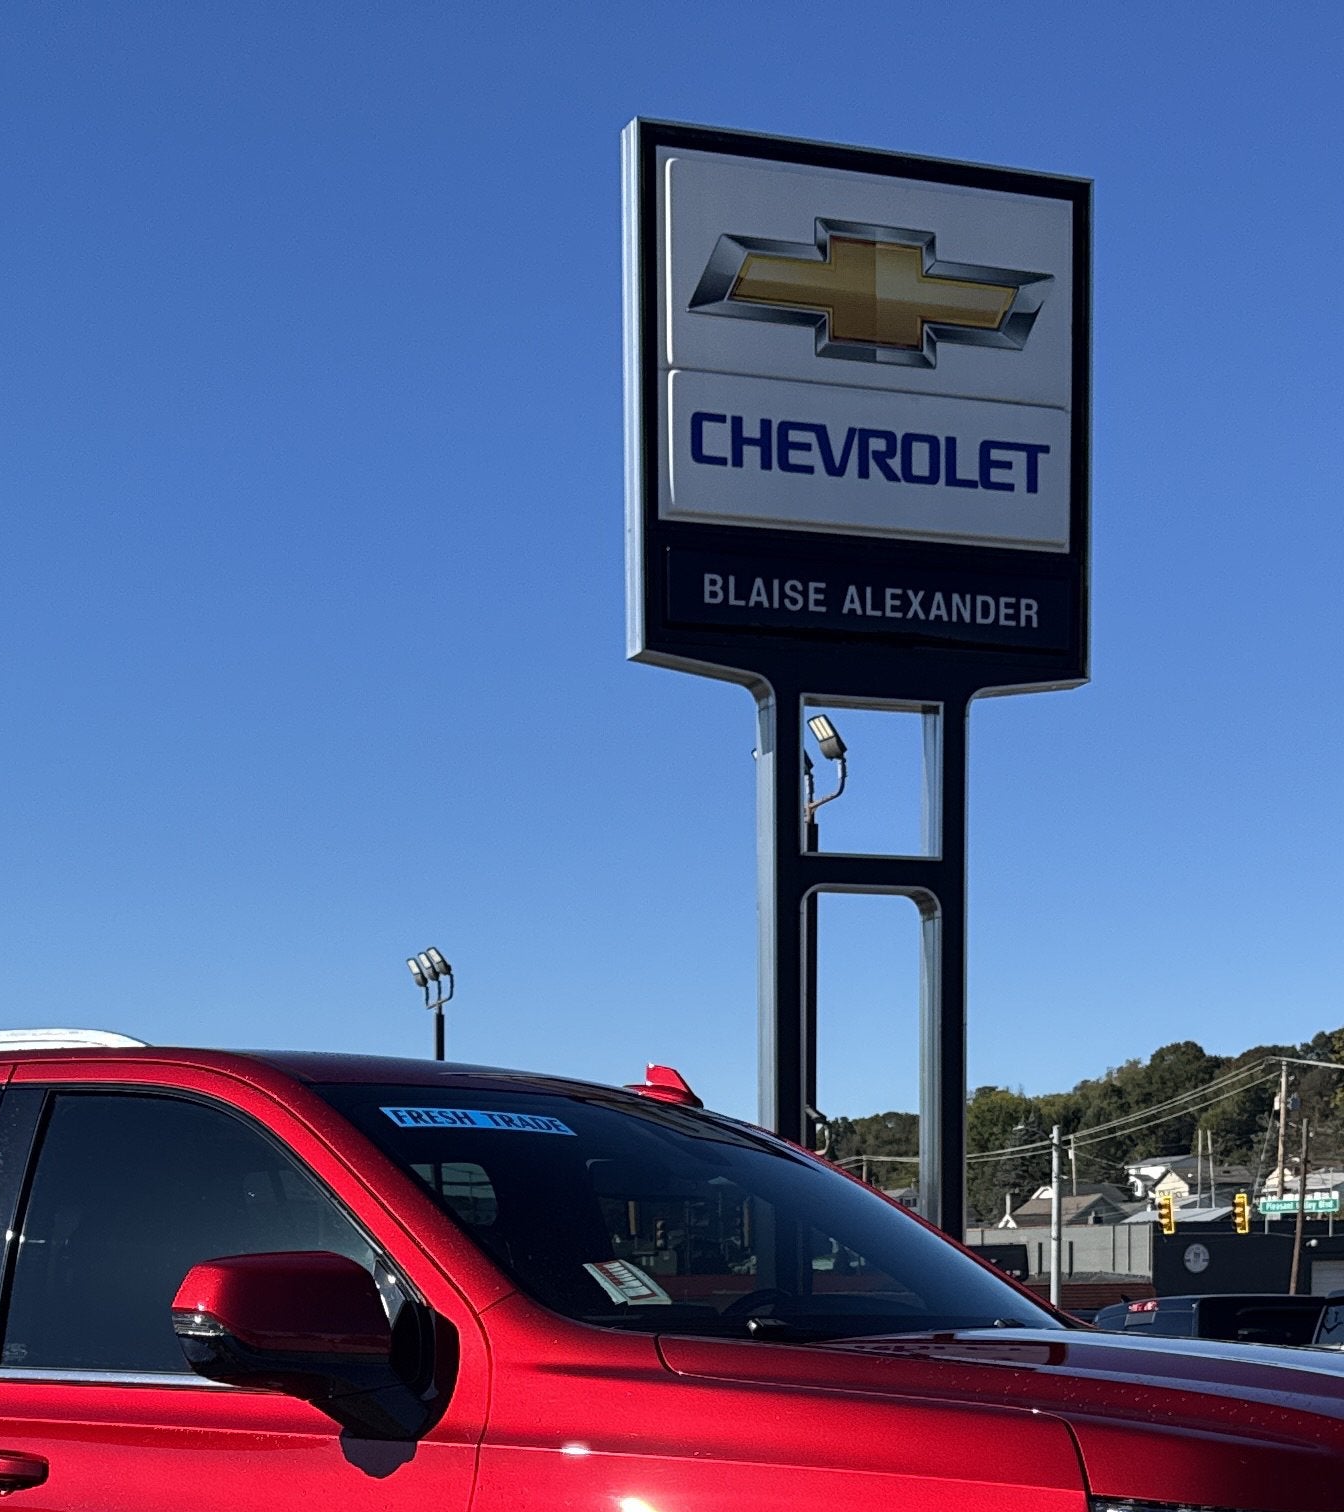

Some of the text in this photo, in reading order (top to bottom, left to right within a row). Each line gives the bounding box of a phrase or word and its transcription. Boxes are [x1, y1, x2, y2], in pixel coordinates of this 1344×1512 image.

[690, 411, 1050, 494] CHEVROLET
[703, 573, 1039, 628] BLAISE ALEXANDER
[390, 1109, 568, 1132] FRESH TRADE
